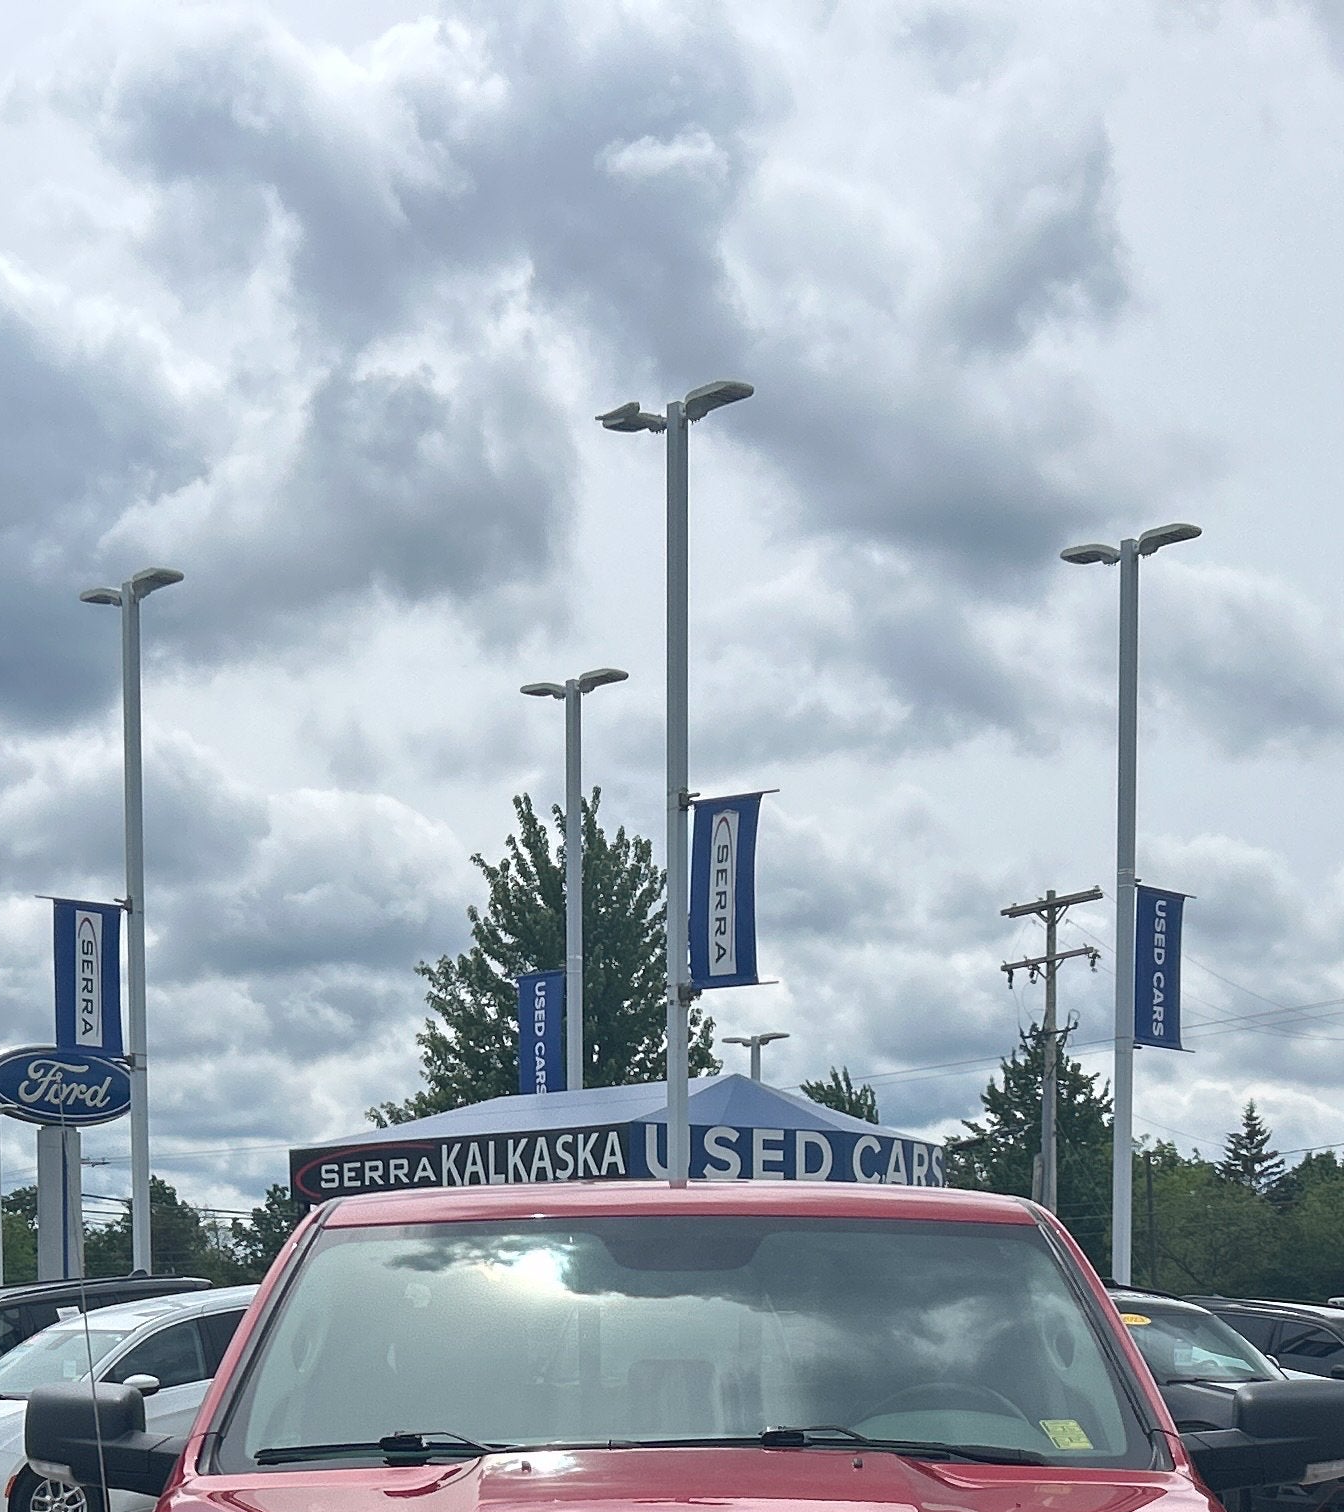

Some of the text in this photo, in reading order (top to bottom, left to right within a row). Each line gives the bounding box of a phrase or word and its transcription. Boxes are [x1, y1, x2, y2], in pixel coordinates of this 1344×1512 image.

[713, 844, 729, 964] SERRA
[81, 939, 94, 1036] SERRA
[1152, 899, 1167, 1036] USED CARS
[17, 1059, 113, 1107] Ford
[534, 981, 547, 1094] USED CARS
[320, 1131, 626, 1188] SERRA KALKASKA
[852, 1135, 943, 1187] CARS
